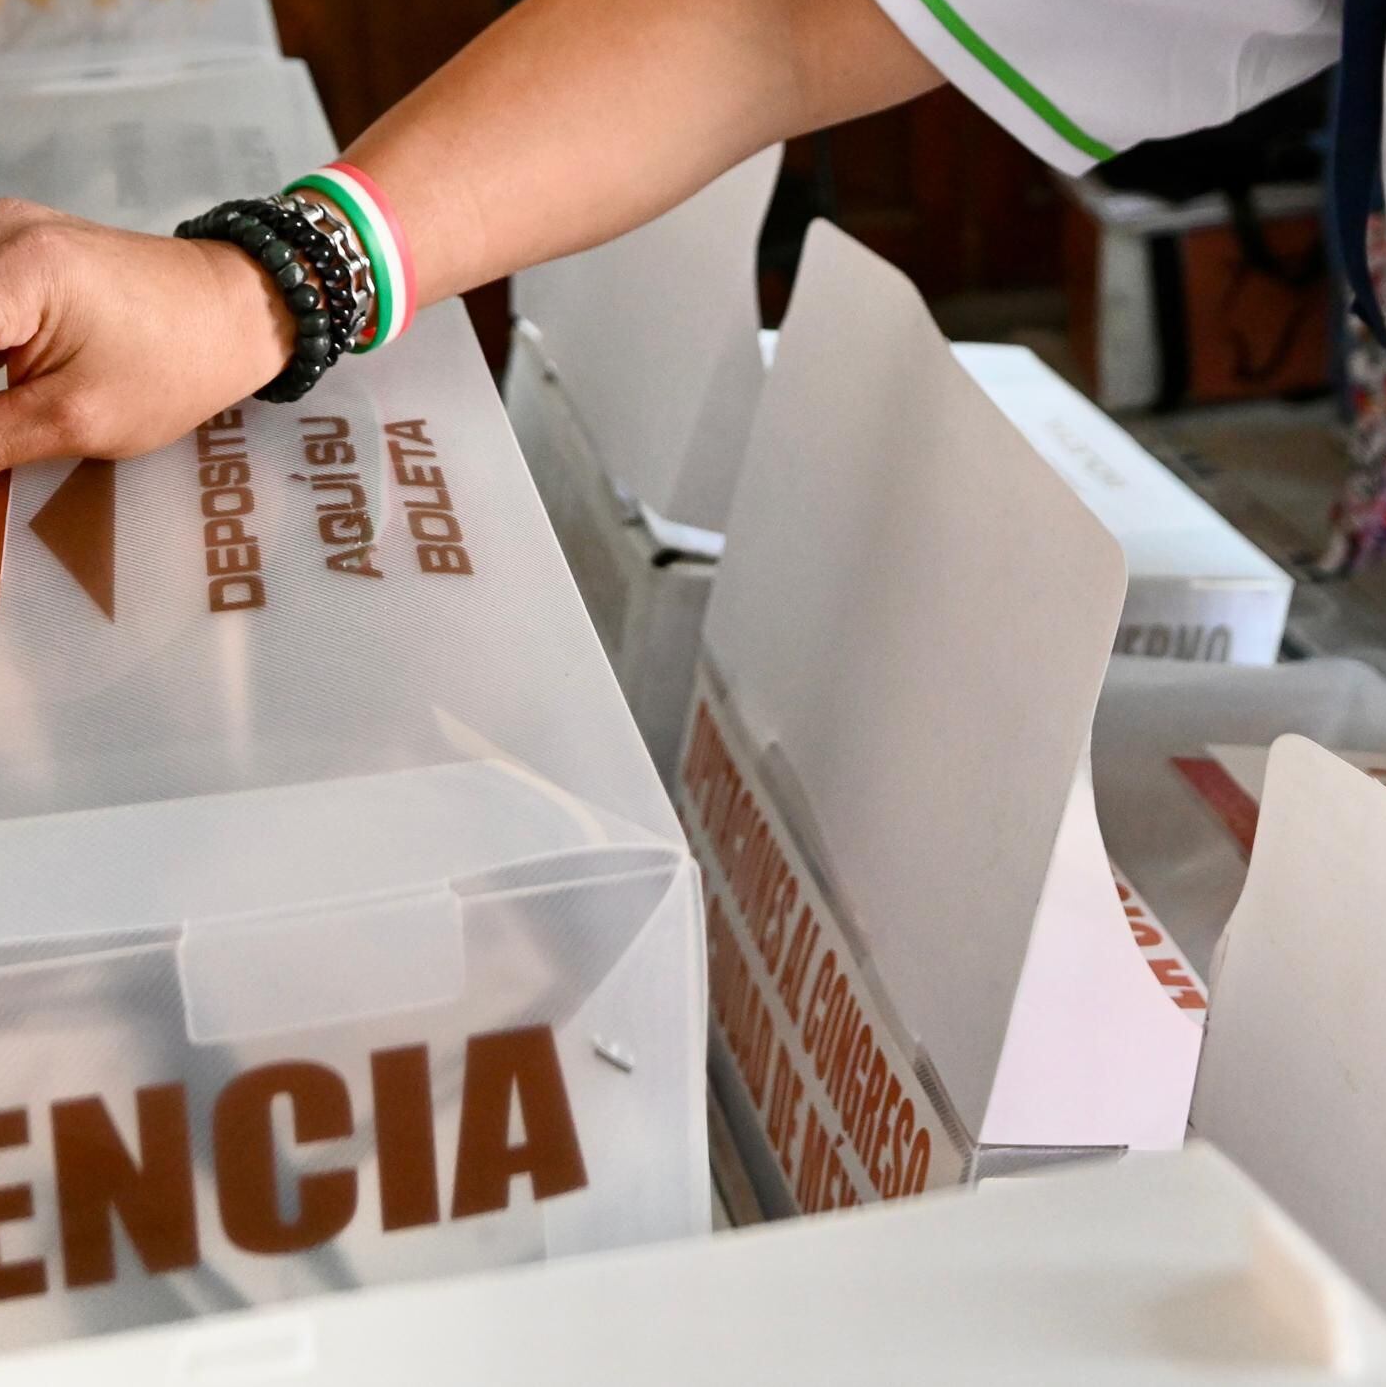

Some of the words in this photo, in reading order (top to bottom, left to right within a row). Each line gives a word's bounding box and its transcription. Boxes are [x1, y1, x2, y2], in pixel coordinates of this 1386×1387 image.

[297, 415, 357, 466] SU
[383, 418, 475, 577] BOLETA
[289, 472, 385, 581] AQUÍ
[766, 1039, 805, 1182] DE
[777, 905, 821, 1026] AL
[801, 948, 931, 1202] CONGRESO
